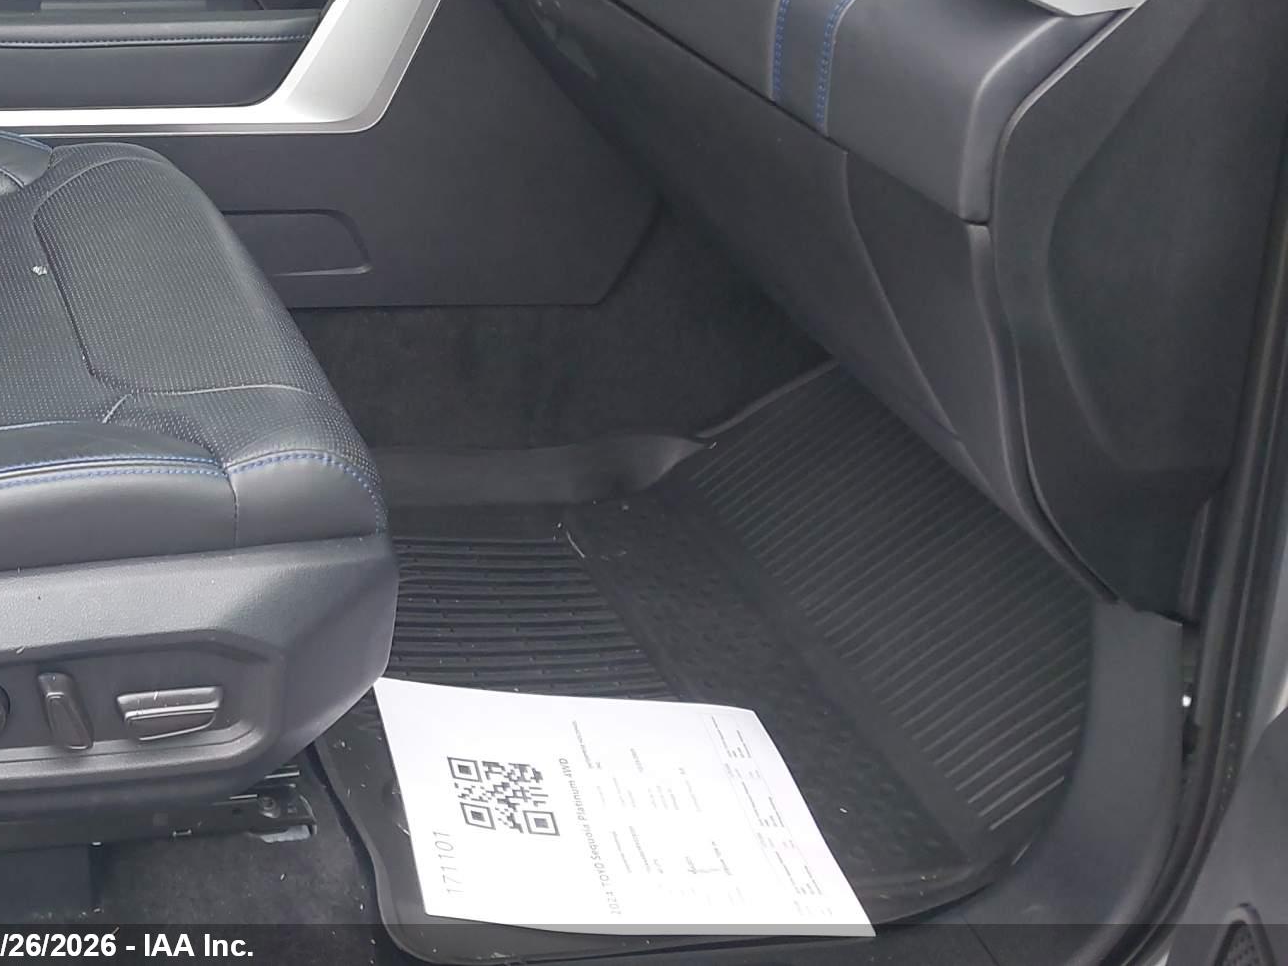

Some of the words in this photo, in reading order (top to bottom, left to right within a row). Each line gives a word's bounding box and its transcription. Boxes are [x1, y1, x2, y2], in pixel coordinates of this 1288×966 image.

[558, 757, 573, 779] 4WD
[568, 779, 590, 822] Platinum
[432, 830, 465, 894] 171101
[582, 823, 602, 861] Sequoia
